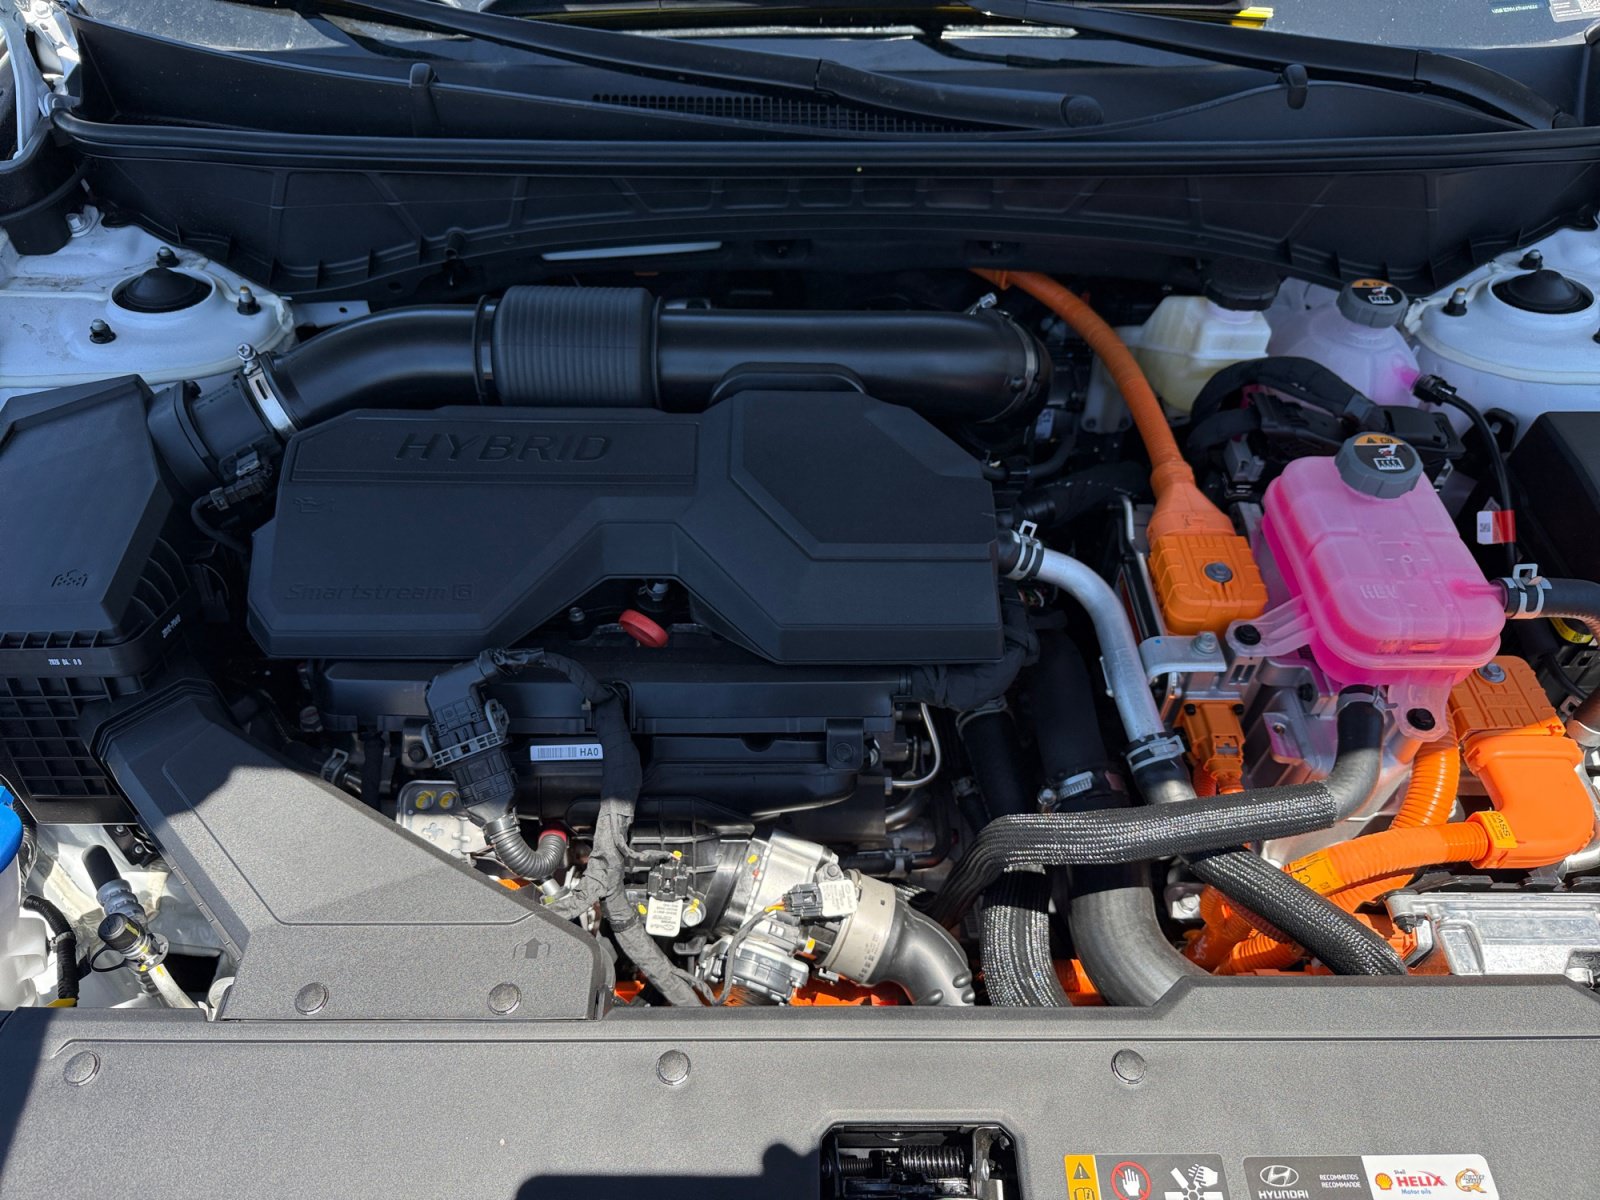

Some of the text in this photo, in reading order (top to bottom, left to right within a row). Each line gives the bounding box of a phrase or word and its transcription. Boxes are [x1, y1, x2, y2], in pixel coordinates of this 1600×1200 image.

[394, 433, 612, 462] HYBRID
[284, 583, 449, 601] Smartstream
[1396, 1175, 1447, 1187] HELIX
[1258, 1190, 1309, 1200] HYUNDAI
